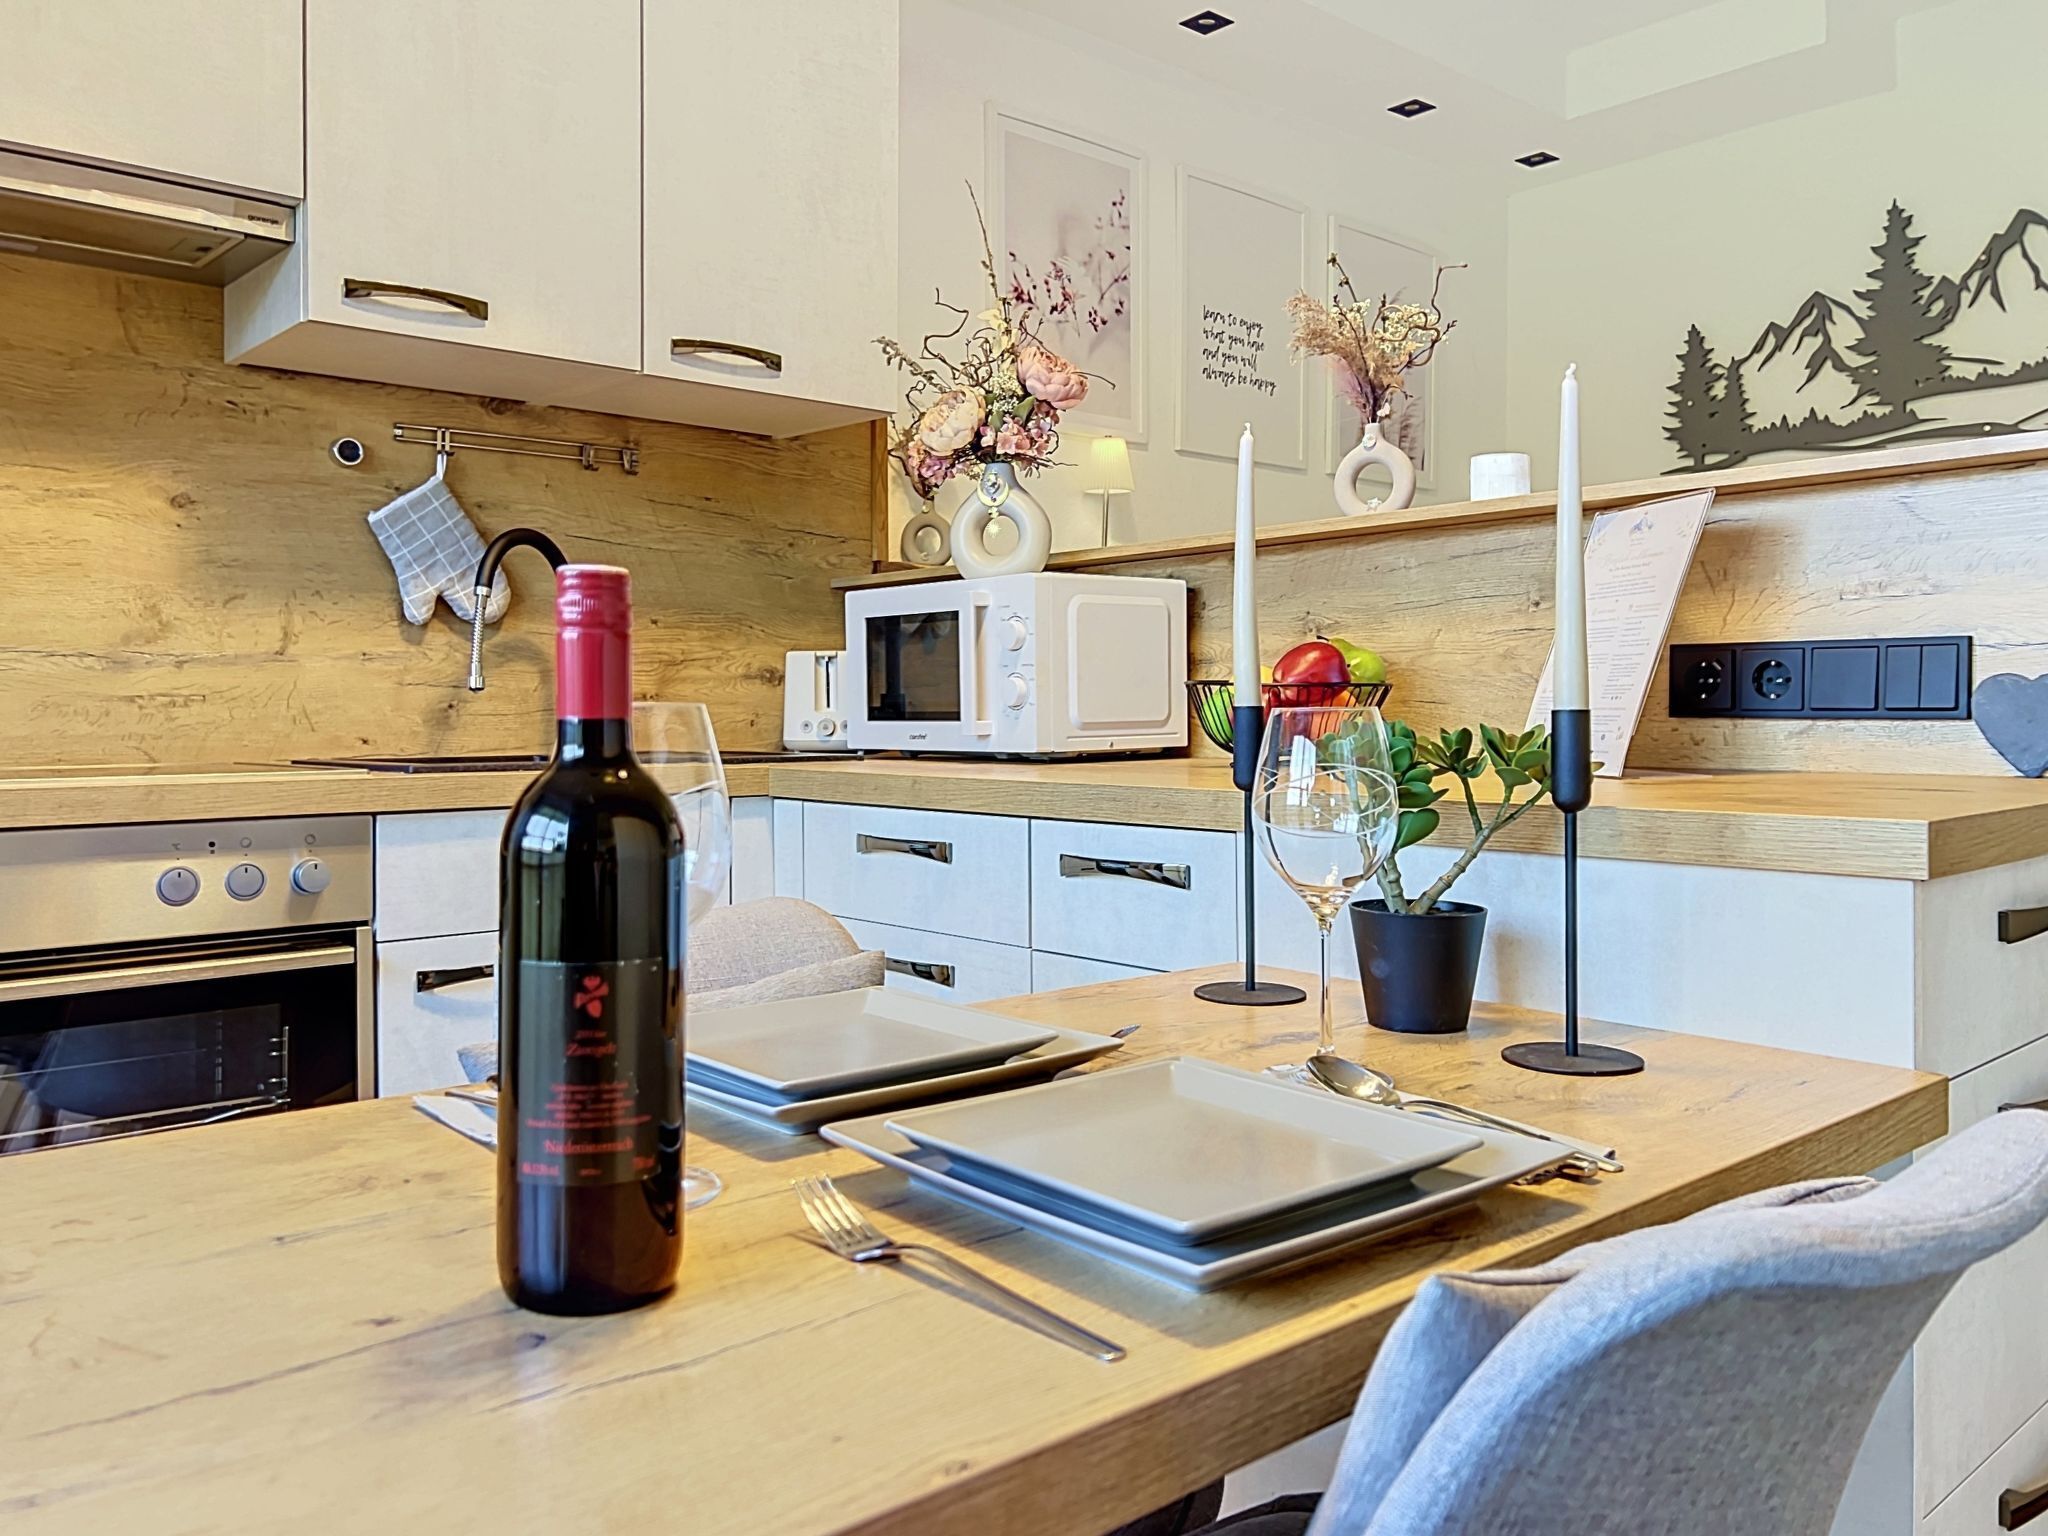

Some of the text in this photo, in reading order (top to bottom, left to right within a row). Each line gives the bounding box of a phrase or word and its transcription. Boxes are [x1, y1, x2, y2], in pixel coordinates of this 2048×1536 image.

[1203, 304, 1264, 338] learn to enjoy
[1203, 326, 1265, 352] what you have
[1202, 345, 1257, 372] and you will
[1202, 363, 1277, 396] always be happy
